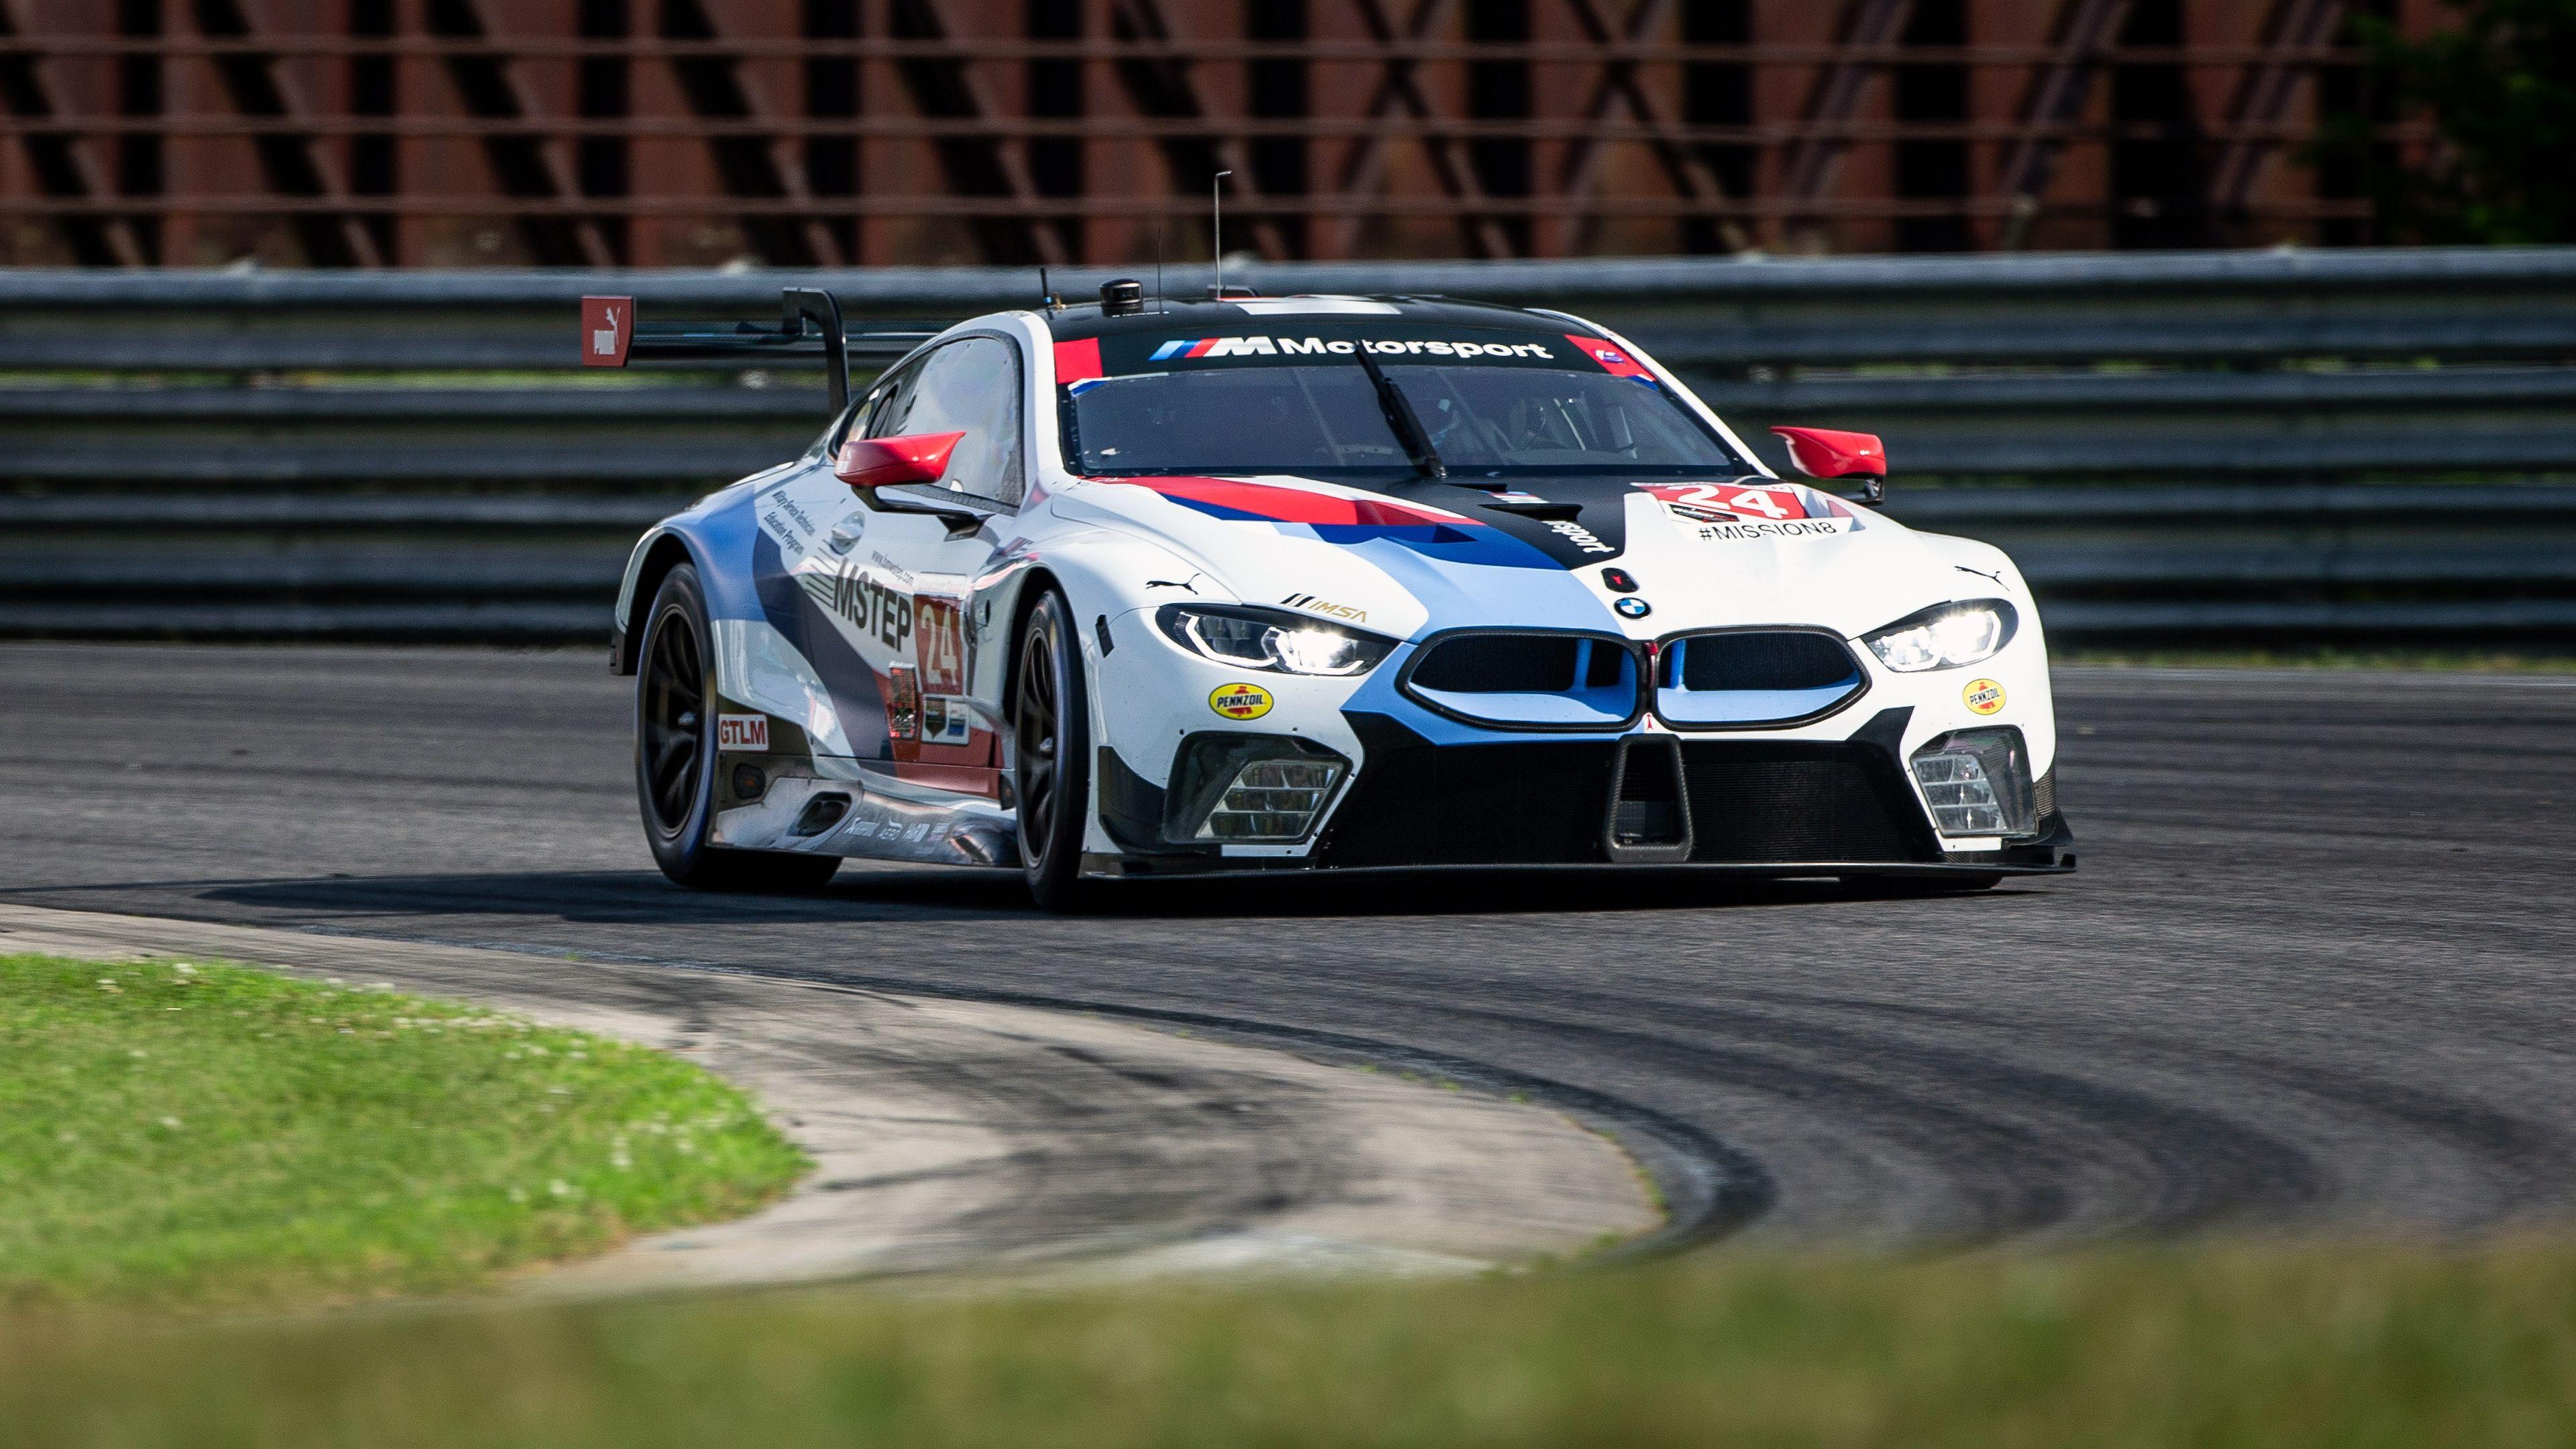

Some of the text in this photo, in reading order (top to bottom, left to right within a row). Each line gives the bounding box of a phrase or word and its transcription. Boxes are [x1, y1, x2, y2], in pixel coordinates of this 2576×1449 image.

[1277, 337, 1554, 359] Motorsport
[1666, 484, 1789, 519] 24
[1699, 522, 1837, 541] #MISSION8
[834, 556, 912, 652] MSTEP
[1308, 601, 1366, 623] IMSA
[921, 604, 958, 685] 24
[1217, 694, 1263, 708] PENNZOIL
[1970, 688, 2000, 705] PENNZOIL
[720, 719, 766, 745] GTLM
